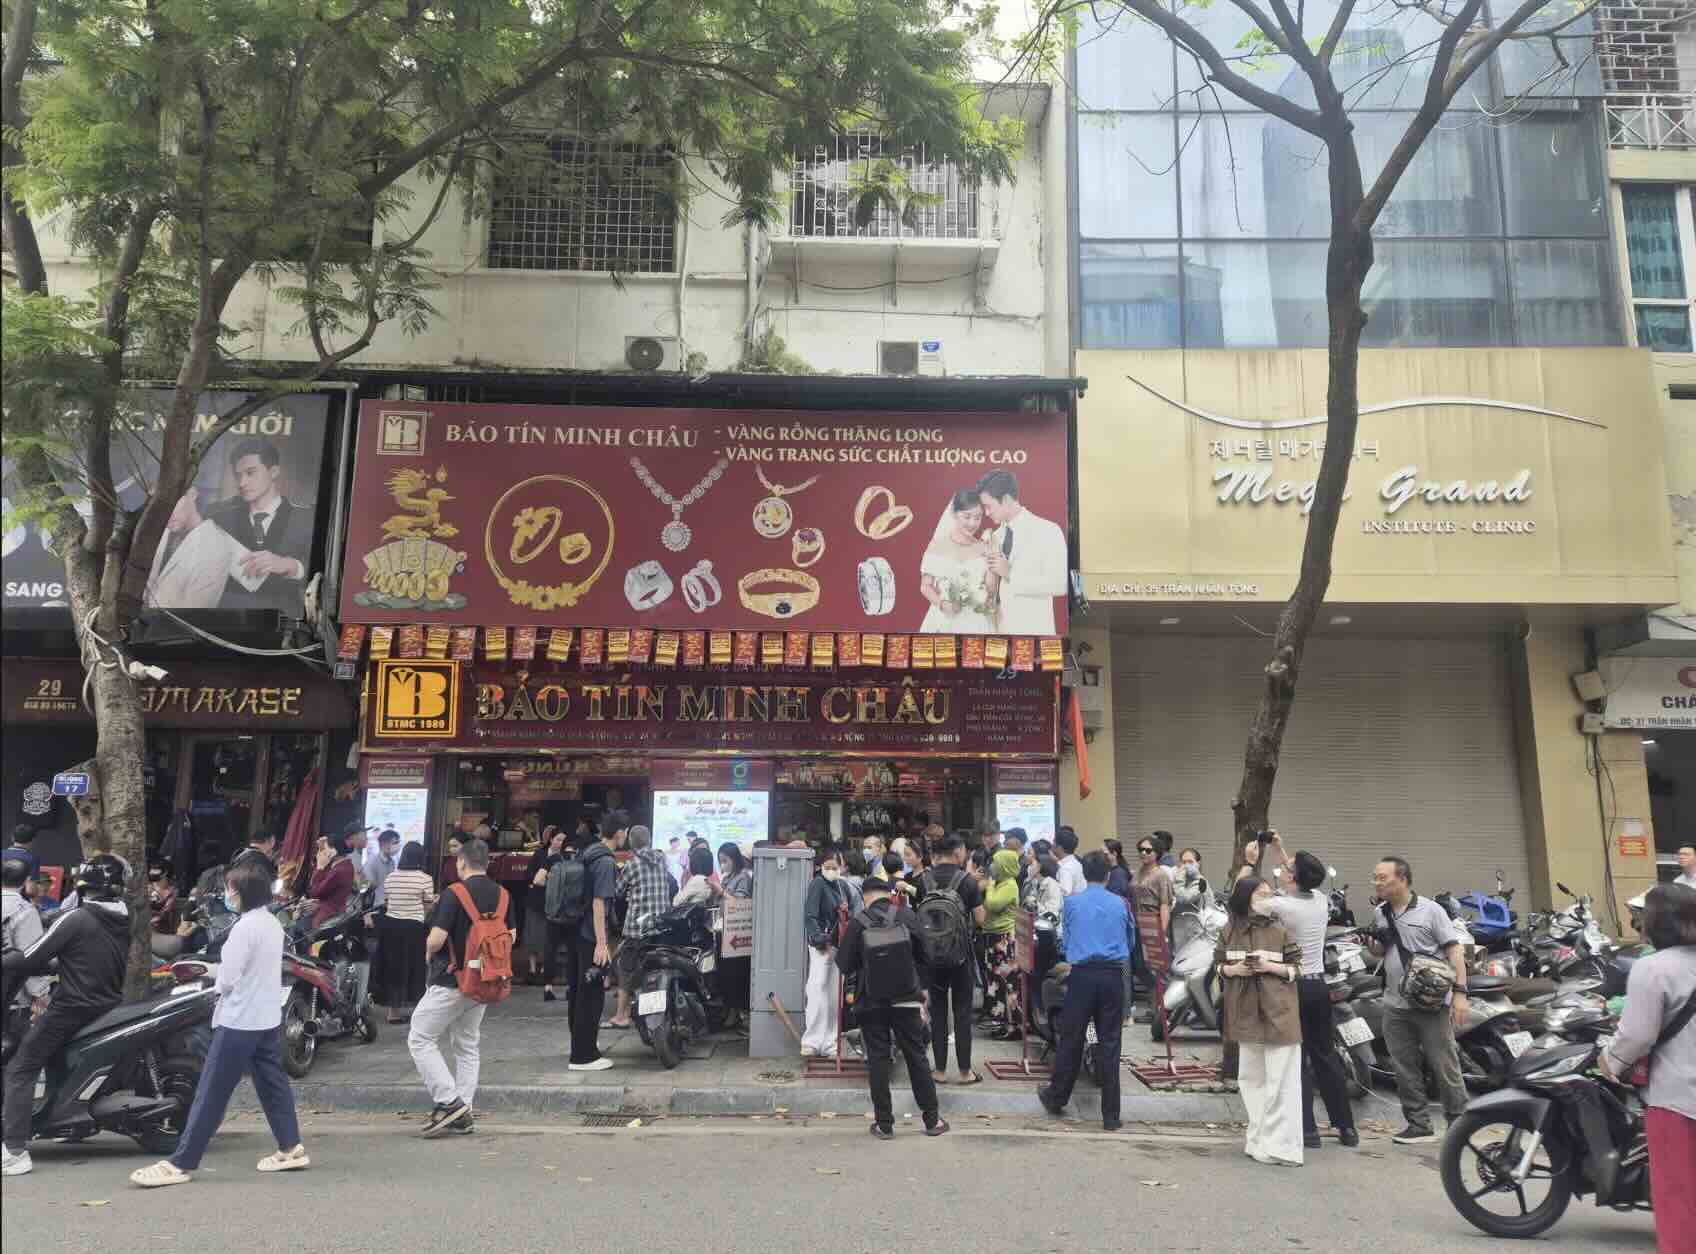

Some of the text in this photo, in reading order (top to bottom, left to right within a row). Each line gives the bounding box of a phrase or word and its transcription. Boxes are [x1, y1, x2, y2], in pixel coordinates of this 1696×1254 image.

[446, 420, 699, 447] BẢO TÍN MINH CHÂU
[727, 424, 775, 441] VÀNG
[779, 420, 829, 441] RỒNG
[833, 424, 891, 441] THĂNG
[895, 428, 944, 442] LONG
[726, 444, 773, 461] VÀNG
[777, 447, 834, 462] TRANG
[839, 445, 872, 462] SỨC
[876, 443, 921, 463] CHẤT
[925, 447, 985, 467] LƯỢNG
[989, 450, 1027, 464] CAO
[1213, 464, 1533, 515] Meg Grand
[1362, 519, 1456, 534] INSTITUTE
[1471, 519, 1537, 534] CLINIC
[5, 581, 63, 598] SANG
[37, 679, 62, 696] 29
[474, 670, 952, 724] BẢO TÍN MINH CHÂU
